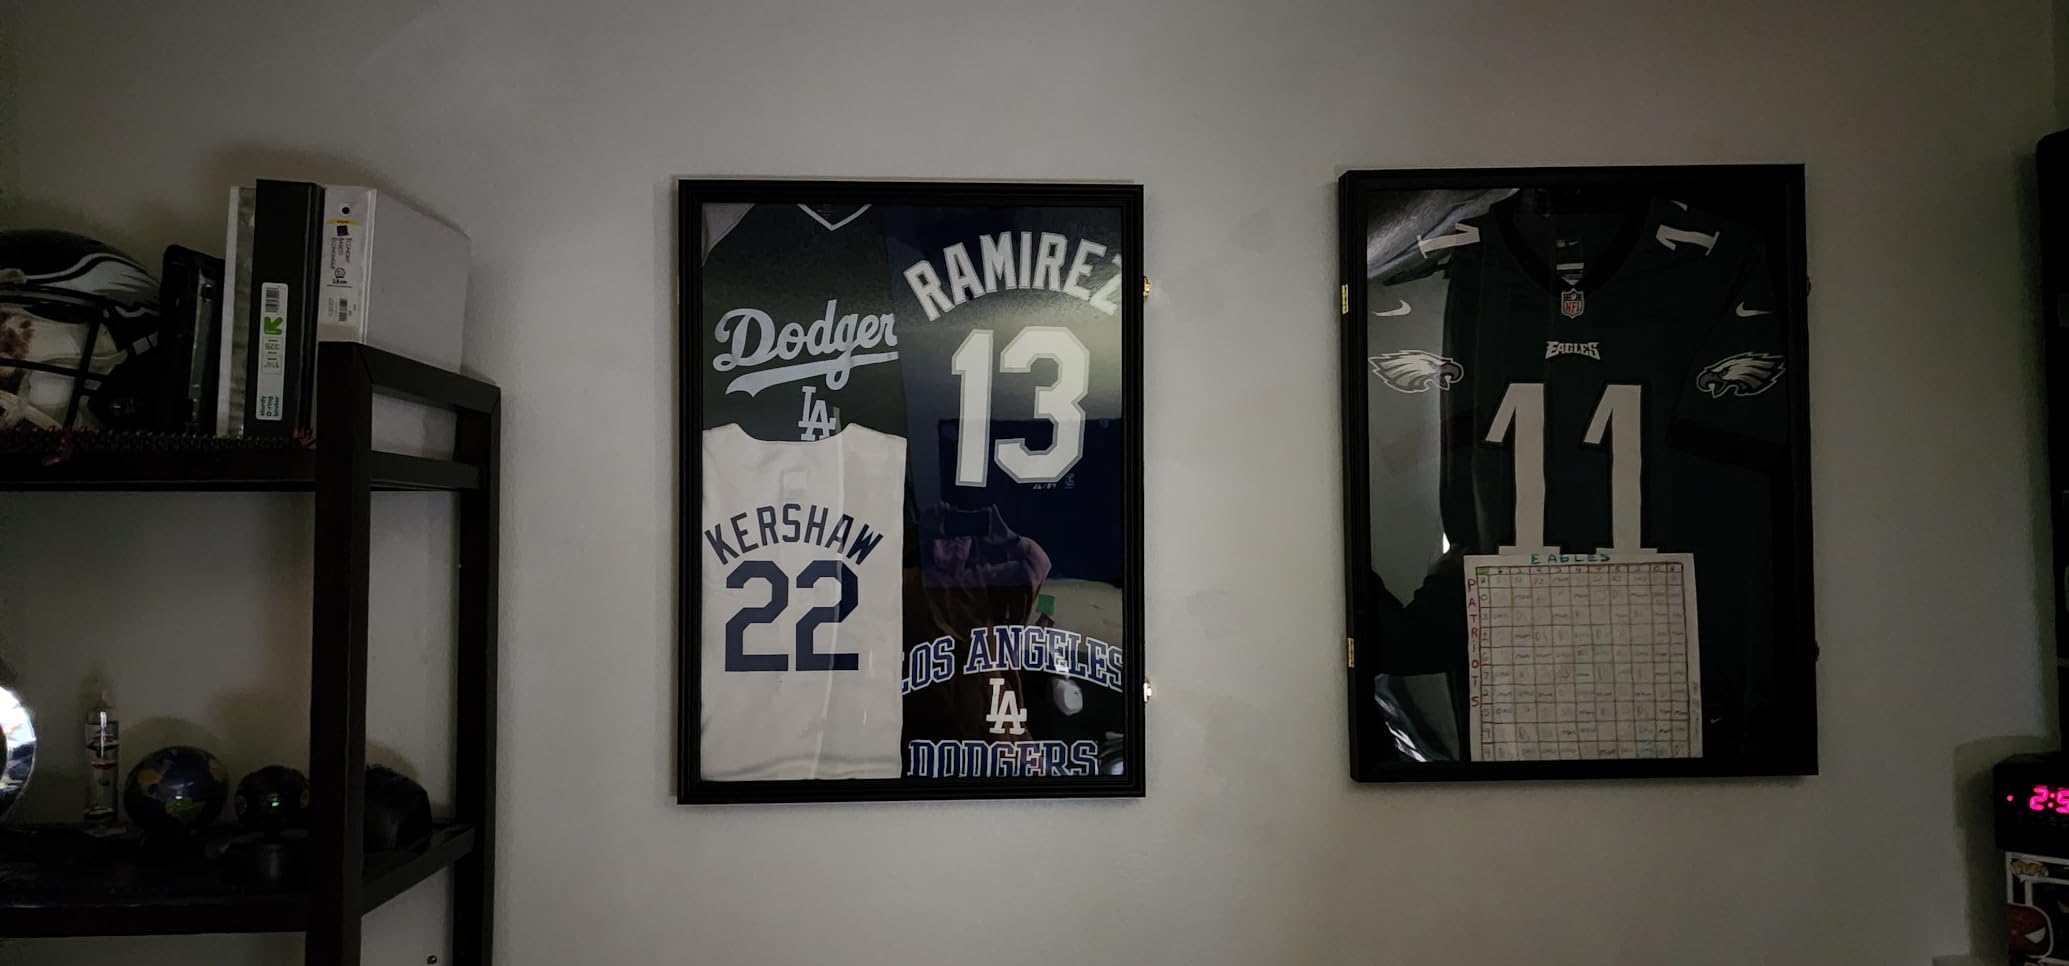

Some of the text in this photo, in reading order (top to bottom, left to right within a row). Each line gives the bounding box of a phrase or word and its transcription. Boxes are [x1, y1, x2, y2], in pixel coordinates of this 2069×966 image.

[903, 230, 1121, 322] RAMIREZ
[1564, 301, 1581, 314] NFL
[713, 299, 898, 392] Dodger
[1545, 340, 1601, 360] EAGLES
[798, 386, 836, 441] LA
[951, 325, 1091, 487] 13
[1481, 381, 1658, 553] 11
[704, 503, 884, 565] KERSHAW
[1531, 554, 1612, 565] EAGLES
[725, 560, 859, 672] 22
[962, 624, 1124, 694] ANGELES
[985, 677, 1028, 734] LA
[907, 739, 1099, 777] DODGERS
[2028, 785, 2069, 814] 2:5
